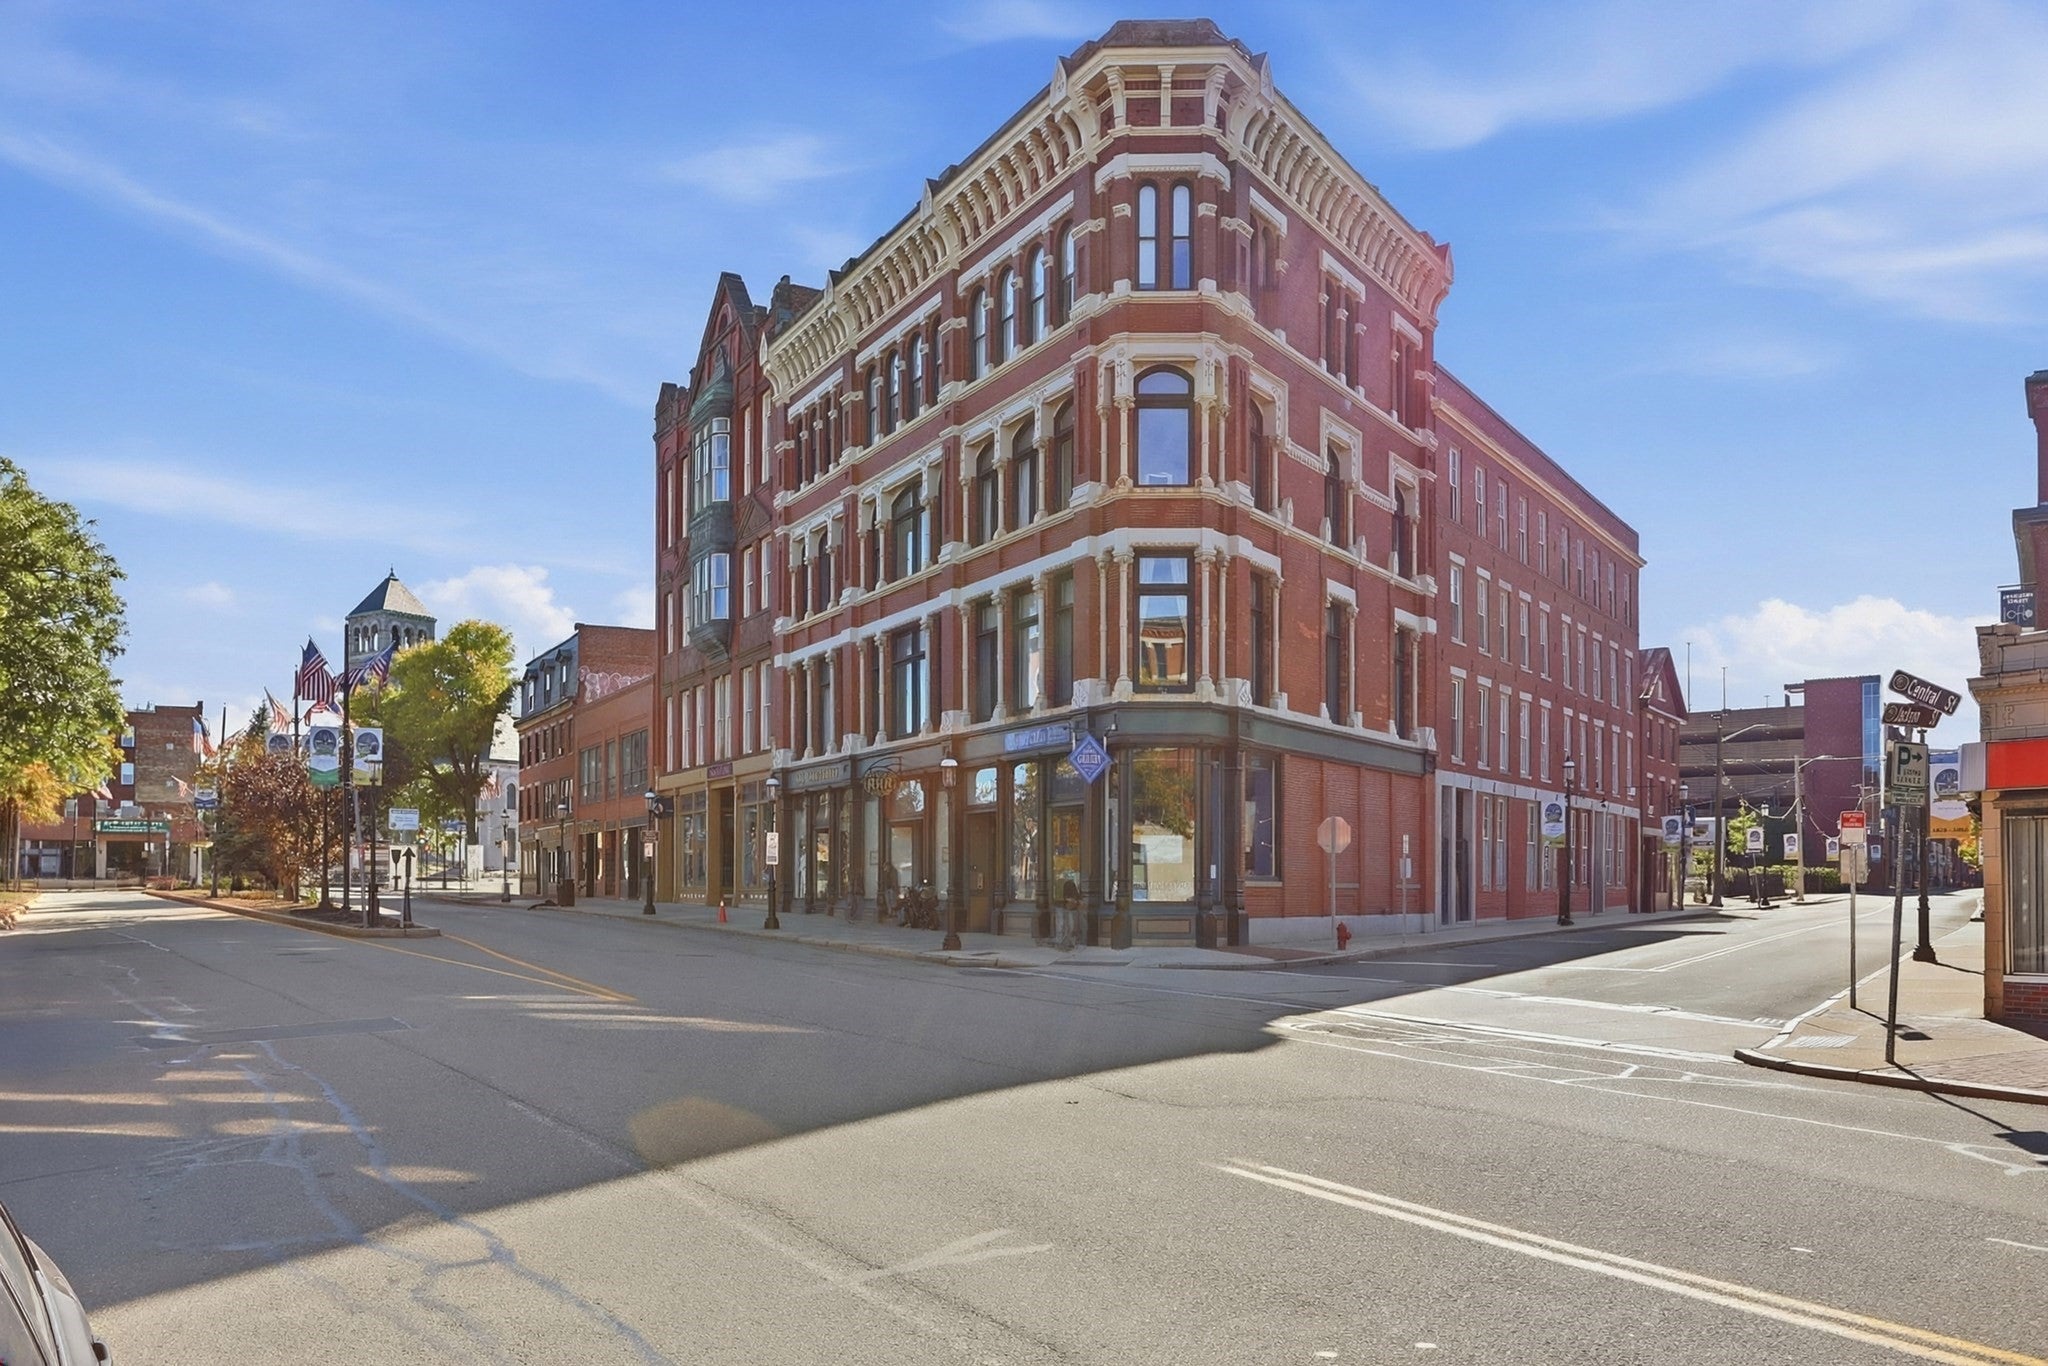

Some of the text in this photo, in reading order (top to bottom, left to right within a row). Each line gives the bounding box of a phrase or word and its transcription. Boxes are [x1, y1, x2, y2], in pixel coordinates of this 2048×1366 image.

[1907, 679, 1958, 713] Central St
[1897, 746, 1911, 775] P
